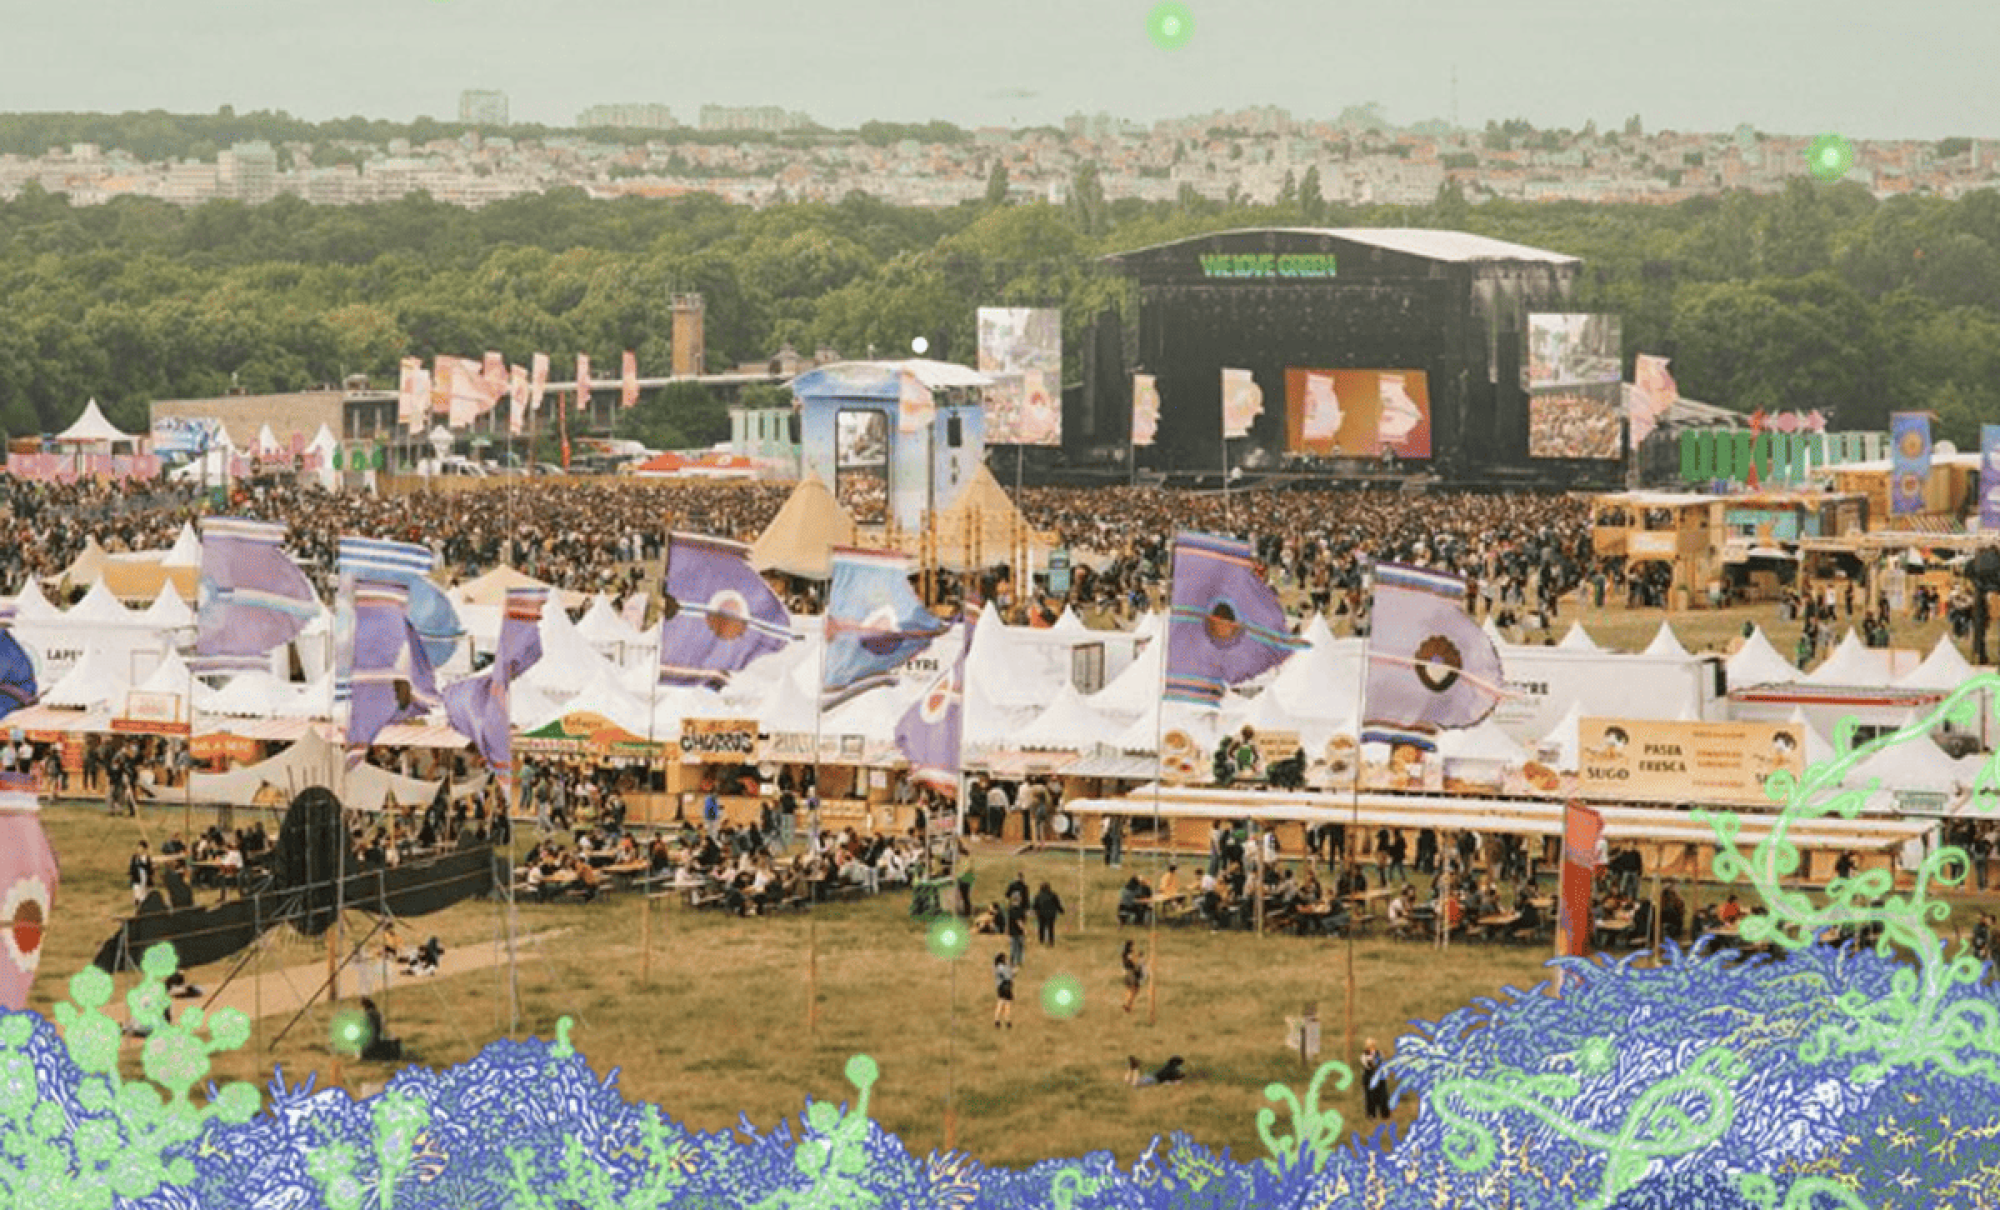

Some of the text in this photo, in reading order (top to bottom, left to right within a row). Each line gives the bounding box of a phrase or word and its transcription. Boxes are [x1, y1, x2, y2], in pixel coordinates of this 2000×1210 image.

[1199, 253, 1337, 277] WE LOVE GREEN
[905, 656, 939, 671] EYRE
[679, 731, 755, 754] CHURROS
[1643, 743, 1683, 756] PASTA
[1586, 766, 1630, 780] SUGO
[1638, 760, 1687, 773] FRESCA
